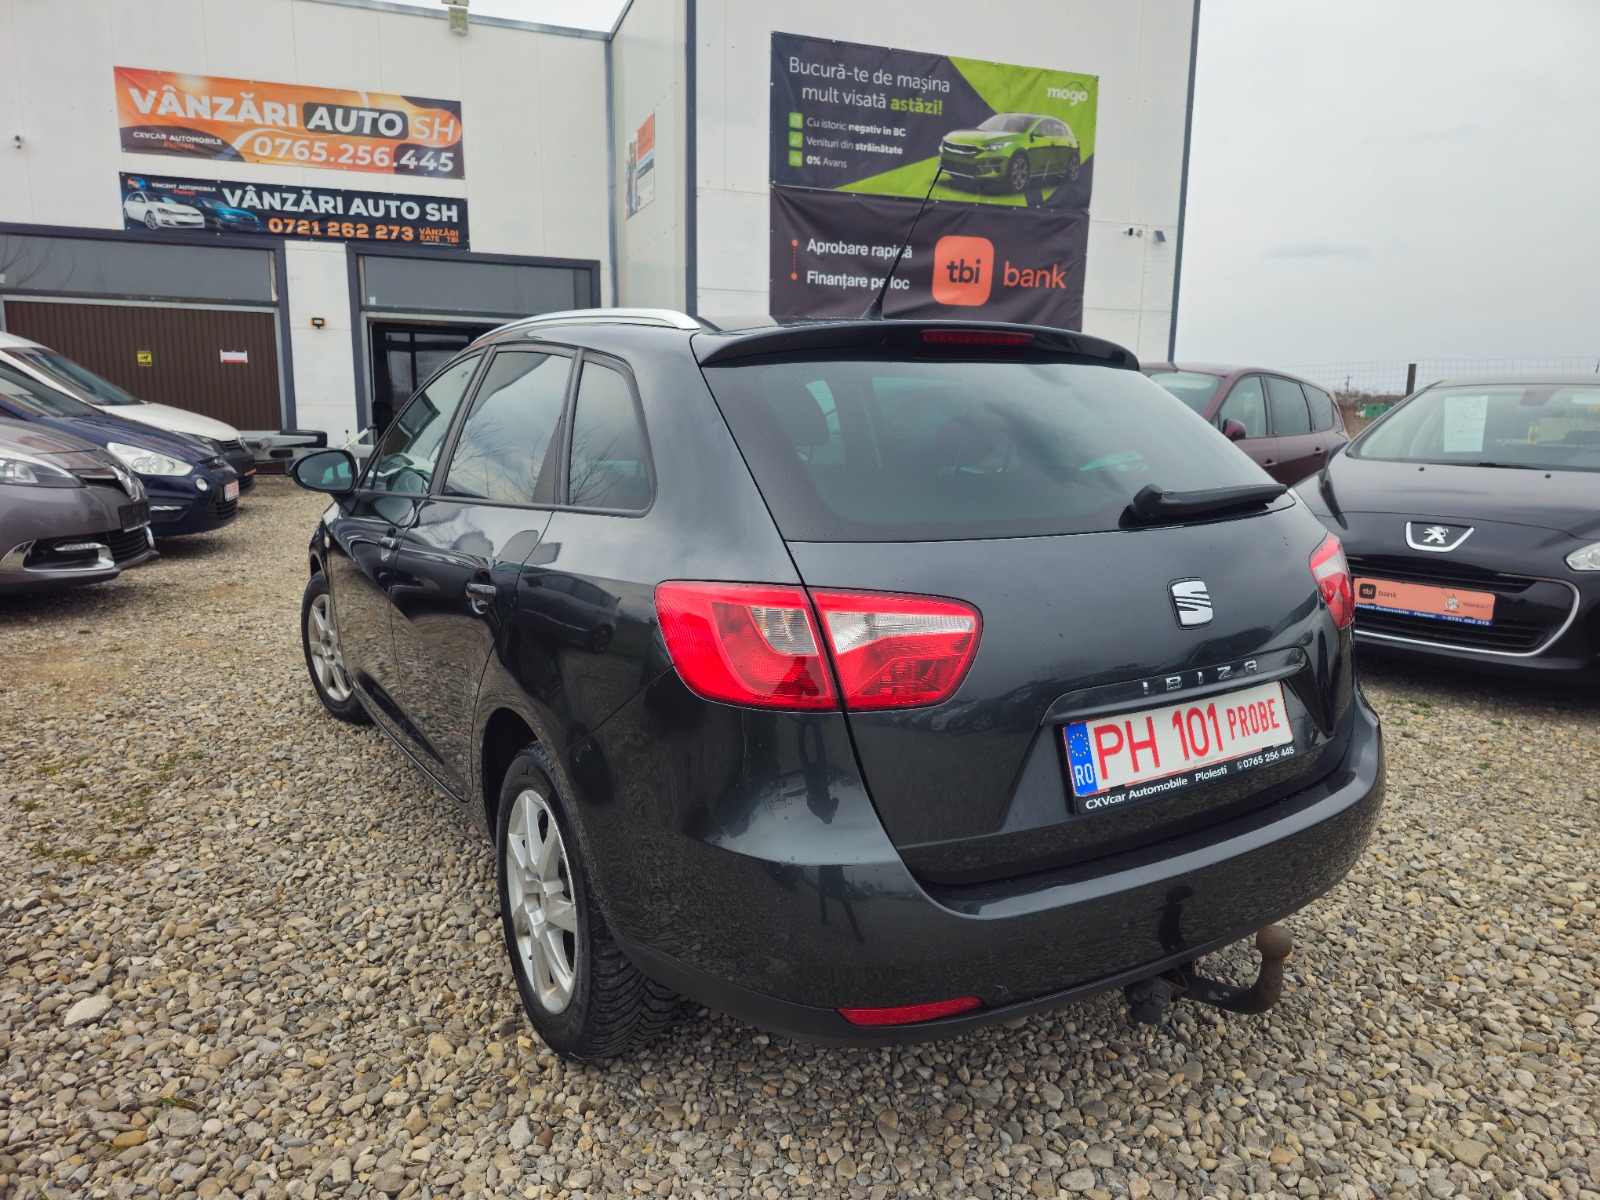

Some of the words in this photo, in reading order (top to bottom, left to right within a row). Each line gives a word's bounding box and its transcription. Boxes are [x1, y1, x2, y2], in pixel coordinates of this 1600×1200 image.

[789, 56, 869, 82] Bucură-te
[872, 69, 893, 86] de
[897, 74, 950, 94] mașina
[802, 87, 840, 104] mult
[843, 90, 886, 109] visată
[890, 97, 943, 115] astăzi!
[1047, 87, 1088, 106] mogo
[128, 84, 298, 128] VÂNZĂRI
[306, 106, 403, 137] AUTO
[413, 116, 455, 142] SH
[133, 131, 167, 140] CXVCAR
[169, 134, 222, 145] AUTOMOBILE
[806, 117, 819, 128] Cu
[821, 118, 847, 130] istoric
[848, 123, 881, 135] negativ
[893, 127, 906, 137] BC
[254, 136, 455, 172] 0765.256.445
[806, 136, 839, 149] Venituri
[840, 140, 854, 150] din
[806, 155, 821, 165] 0%
[823, 158, 847, 169] Avans
[178, 184, 216, 192] AUTOMOBILE
[222, 186, 345, 215] VÂNZĂRI
[350, 198, 421, 220] AUTO
[425, 203, 458, 223] SH
[268, 217, 321, 236] 0721
[327, 220, 369, 239] 262
[375, 223, 415, 242] 273
[420, 234, 440, 242] RATE
[807, 238, 869, 256] Aprobare
[806, 270, 868, 290] Finanțare
[890, 275, 910, 290] loc
[946, 258, 981, 284] tbi
[1003, 261, 1066, 290] bank
[1362, 586, 1373, 596] tbi
[1378, 589, 1397, 599] bank
[1142, 659, 1258, 695] IBIZA
[1093, 716, 1161, 781] PH
[1171, 702, 1224, 761] 101
[1226, 698, 1280, 741] PROBE
[1074, 762, 1095, 787] RO
[1085, 793, 1126, 810] CXVcar
[1129, 776, 1188, 800] Automobile
[1195, 765, 1228, 782] Ploiesti
[1242, 755, 1264, 769] 0765
[1264, 751, 1280, 764] 256
[1280, 746, 1295, 759] 445
